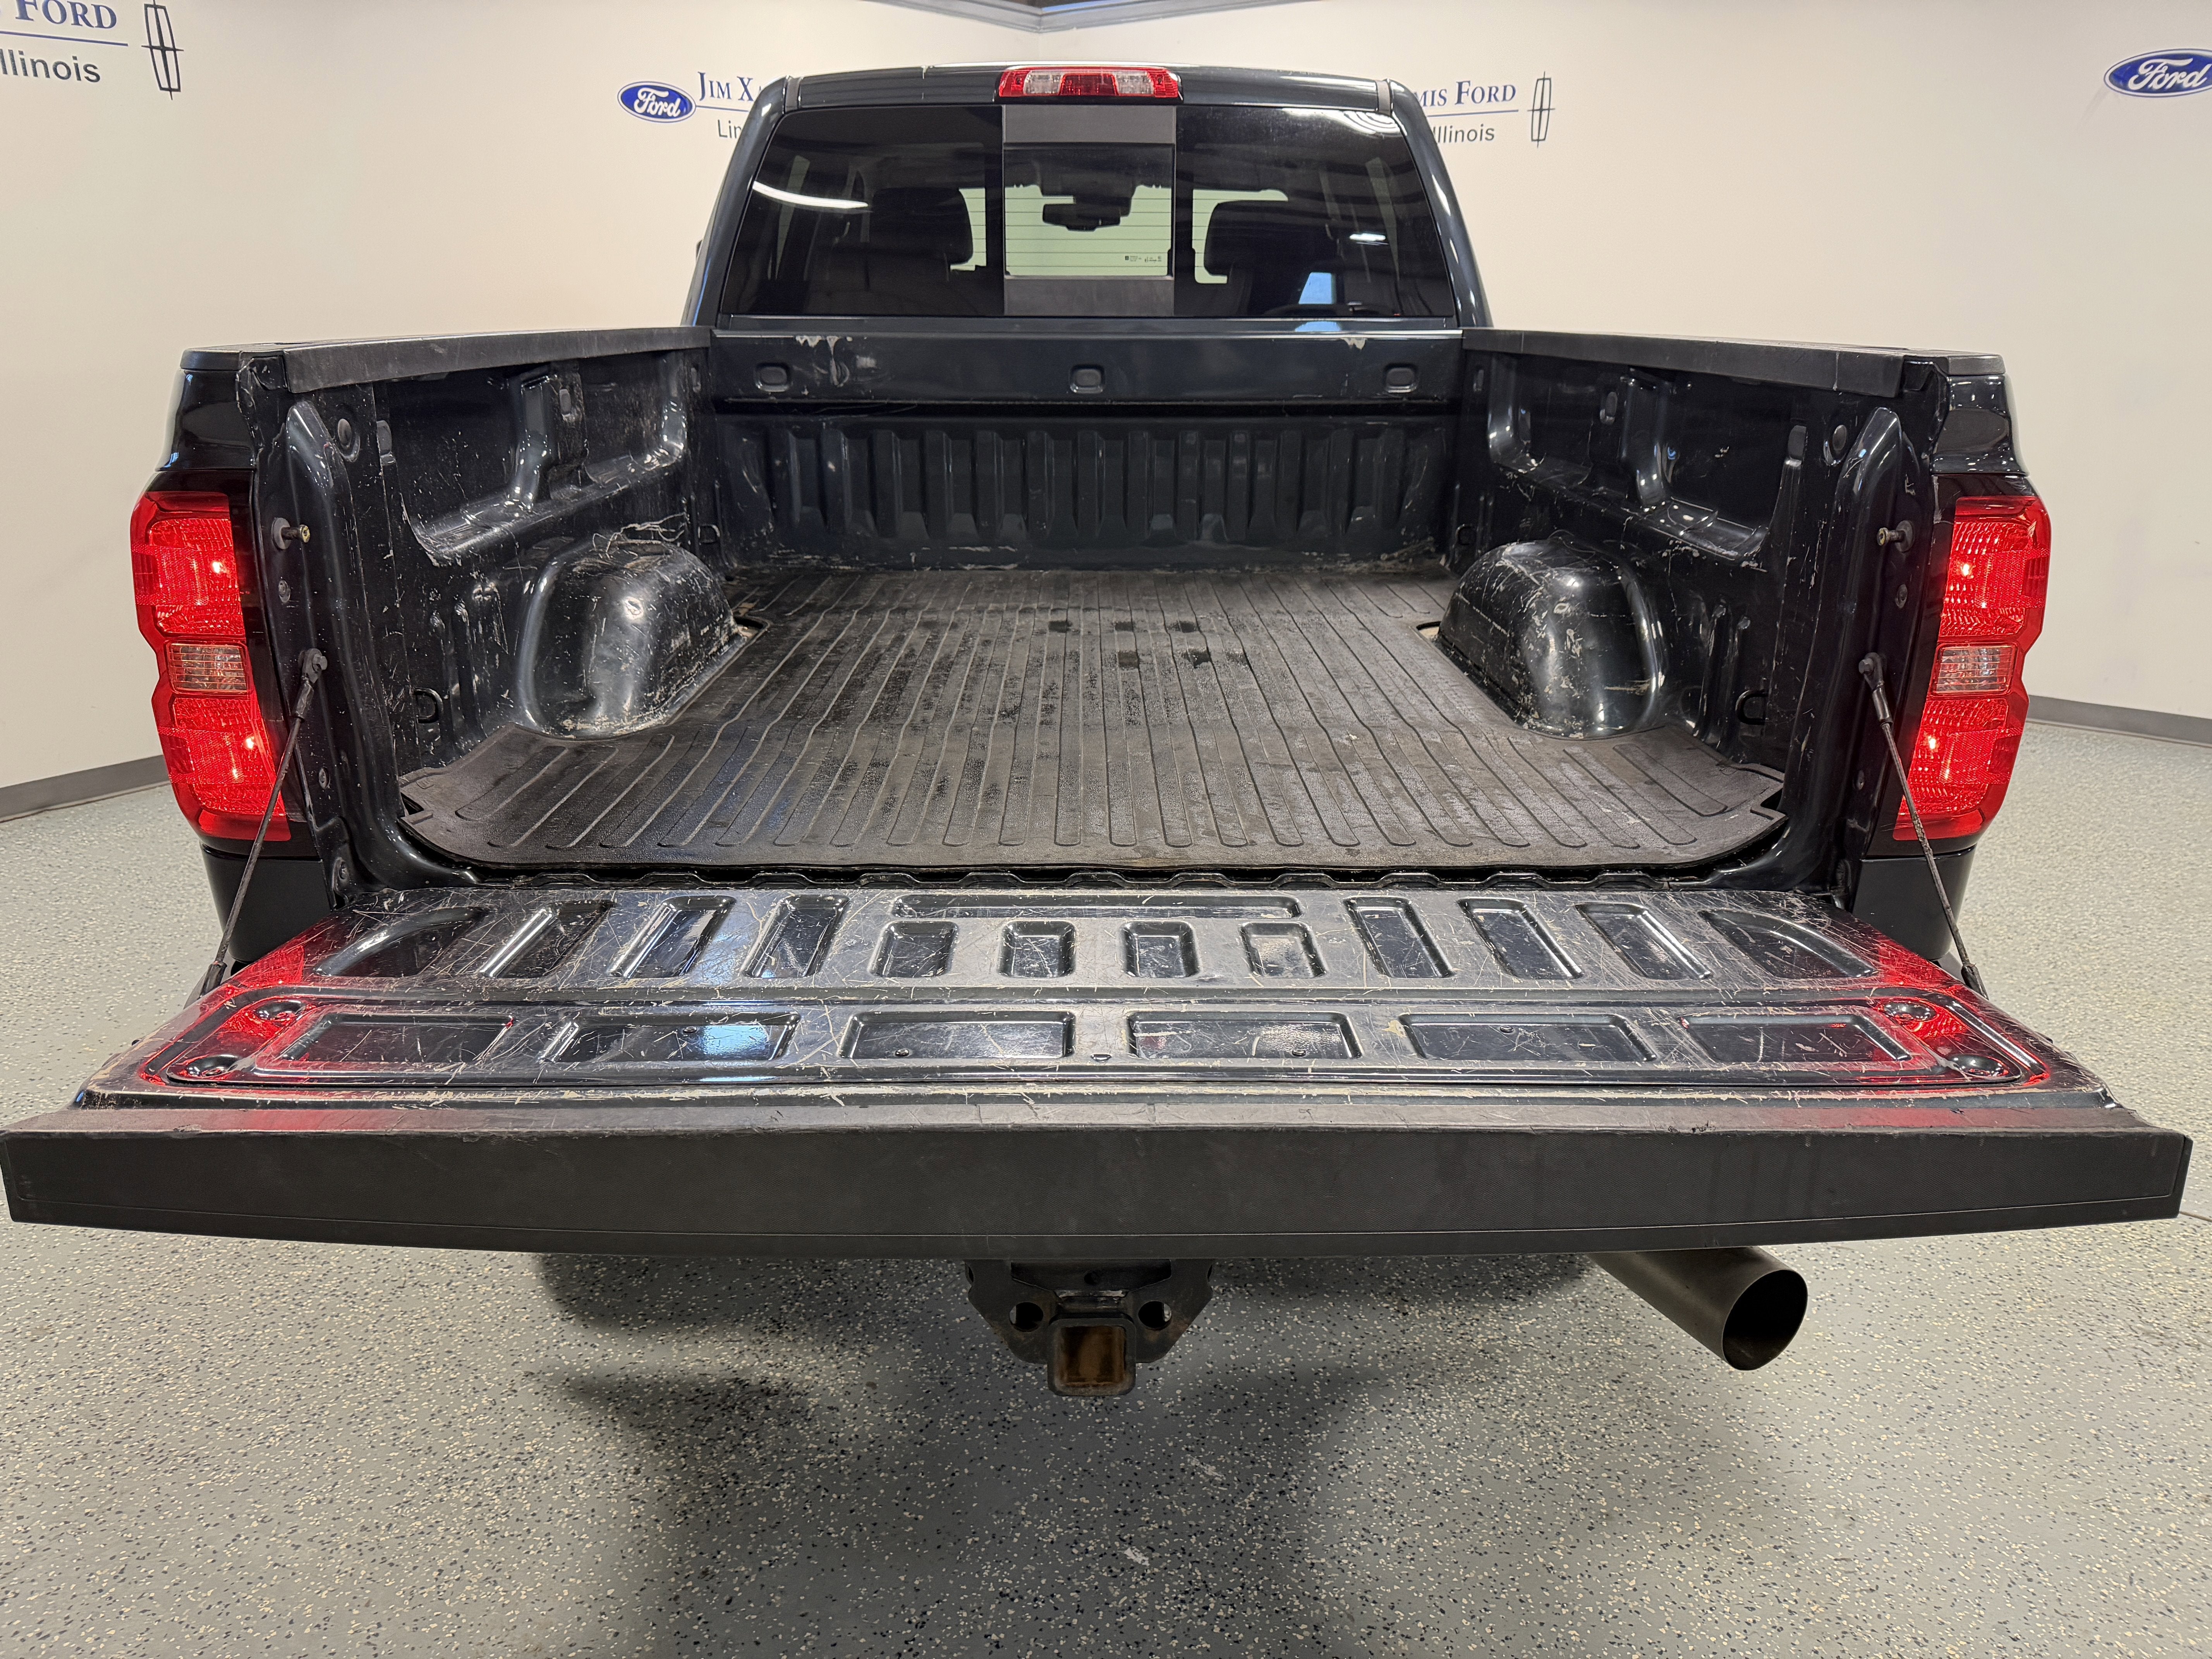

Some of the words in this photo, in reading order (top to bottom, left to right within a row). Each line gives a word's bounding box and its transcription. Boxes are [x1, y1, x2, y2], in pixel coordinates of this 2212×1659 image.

[15, 0, 117, 28] FORD
[698, 72, 731, 101] JIM
[2128, 58, 2212, 90] Ford
[634, 88, 680, 117] Ford
[1455, 81, 1516, 105] FORD
